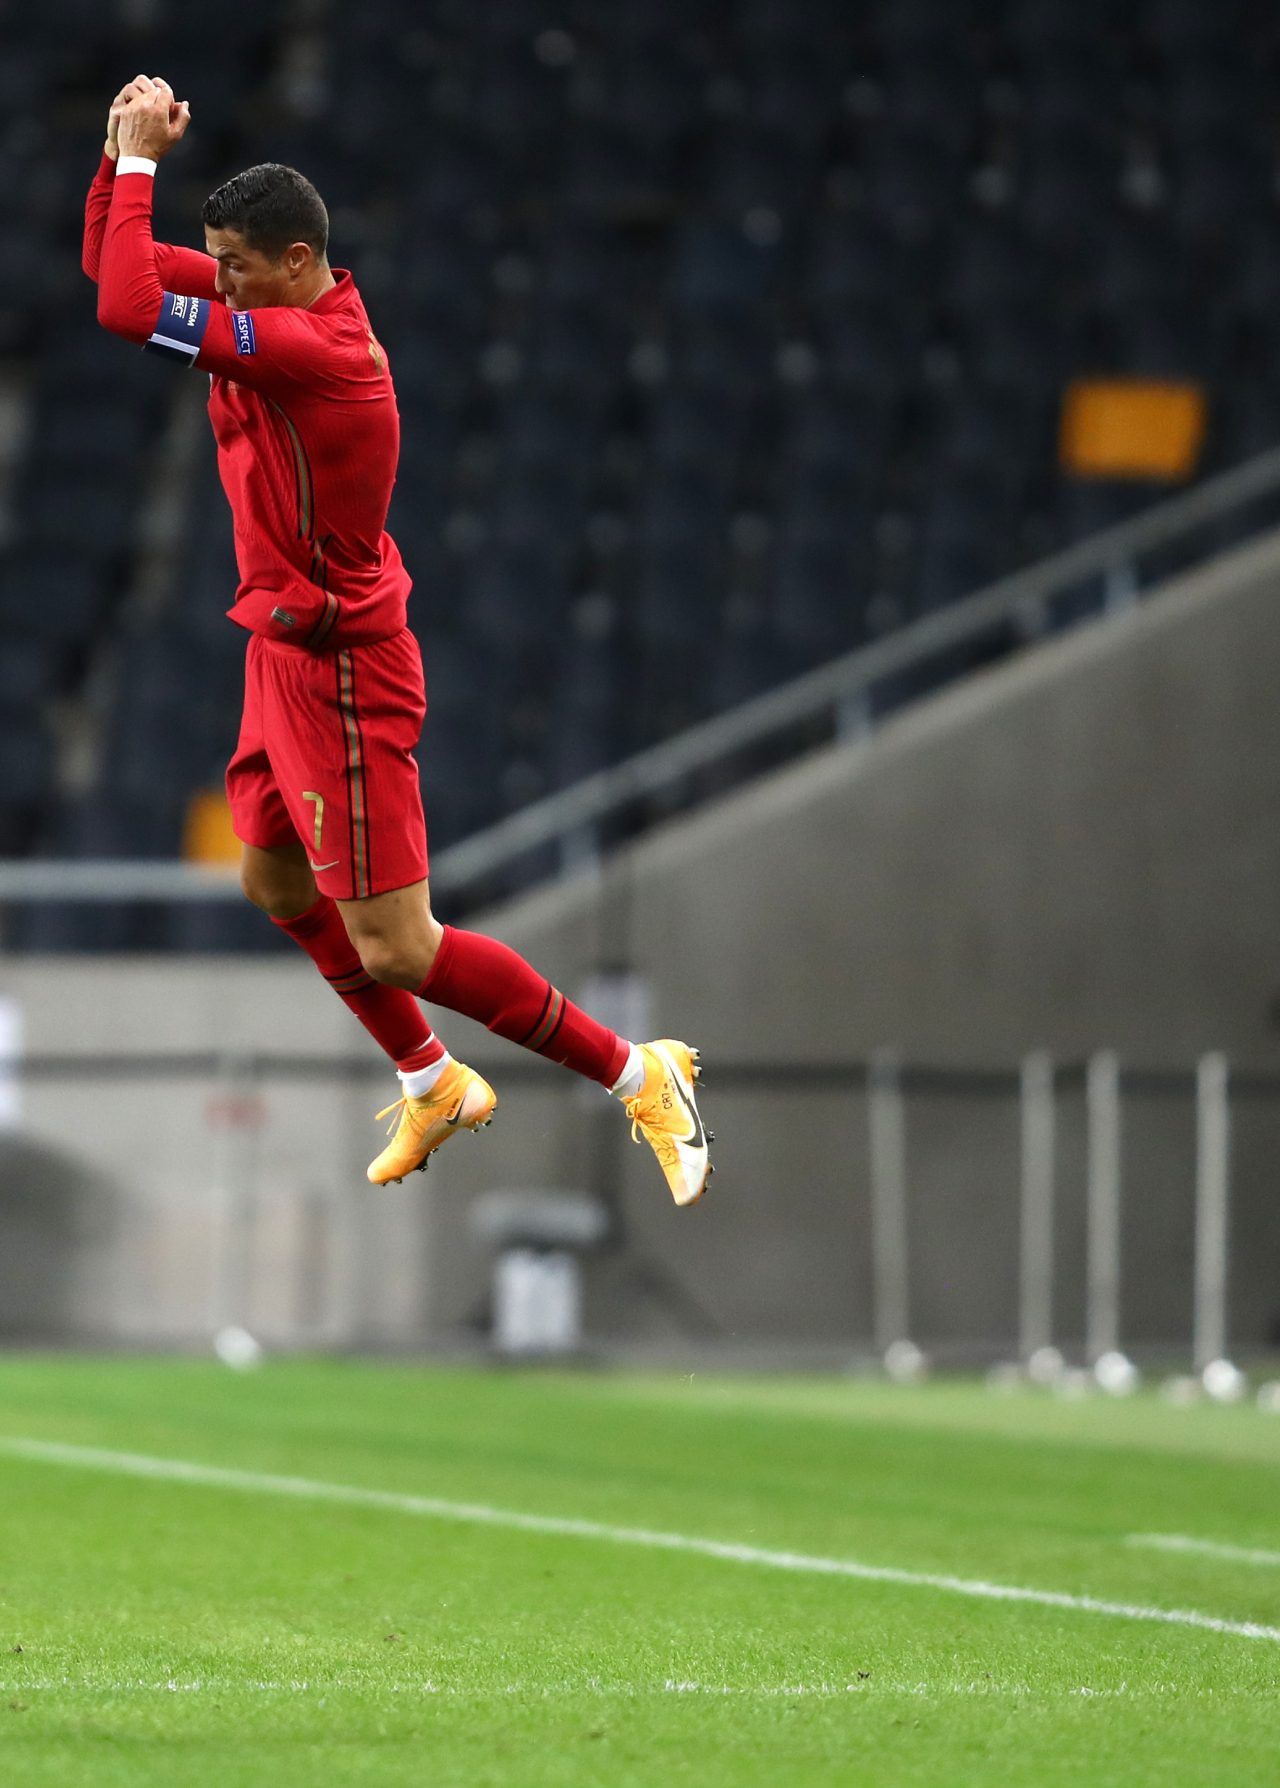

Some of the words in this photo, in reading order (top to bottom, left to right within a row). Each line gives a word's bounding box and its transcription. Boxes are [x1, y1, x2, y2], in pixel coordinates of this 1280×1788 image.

[236, 314, 251, 355] RESPECT
[302, 791, 324, 851] 7
[661, 1092, 673, 1110] CR7
